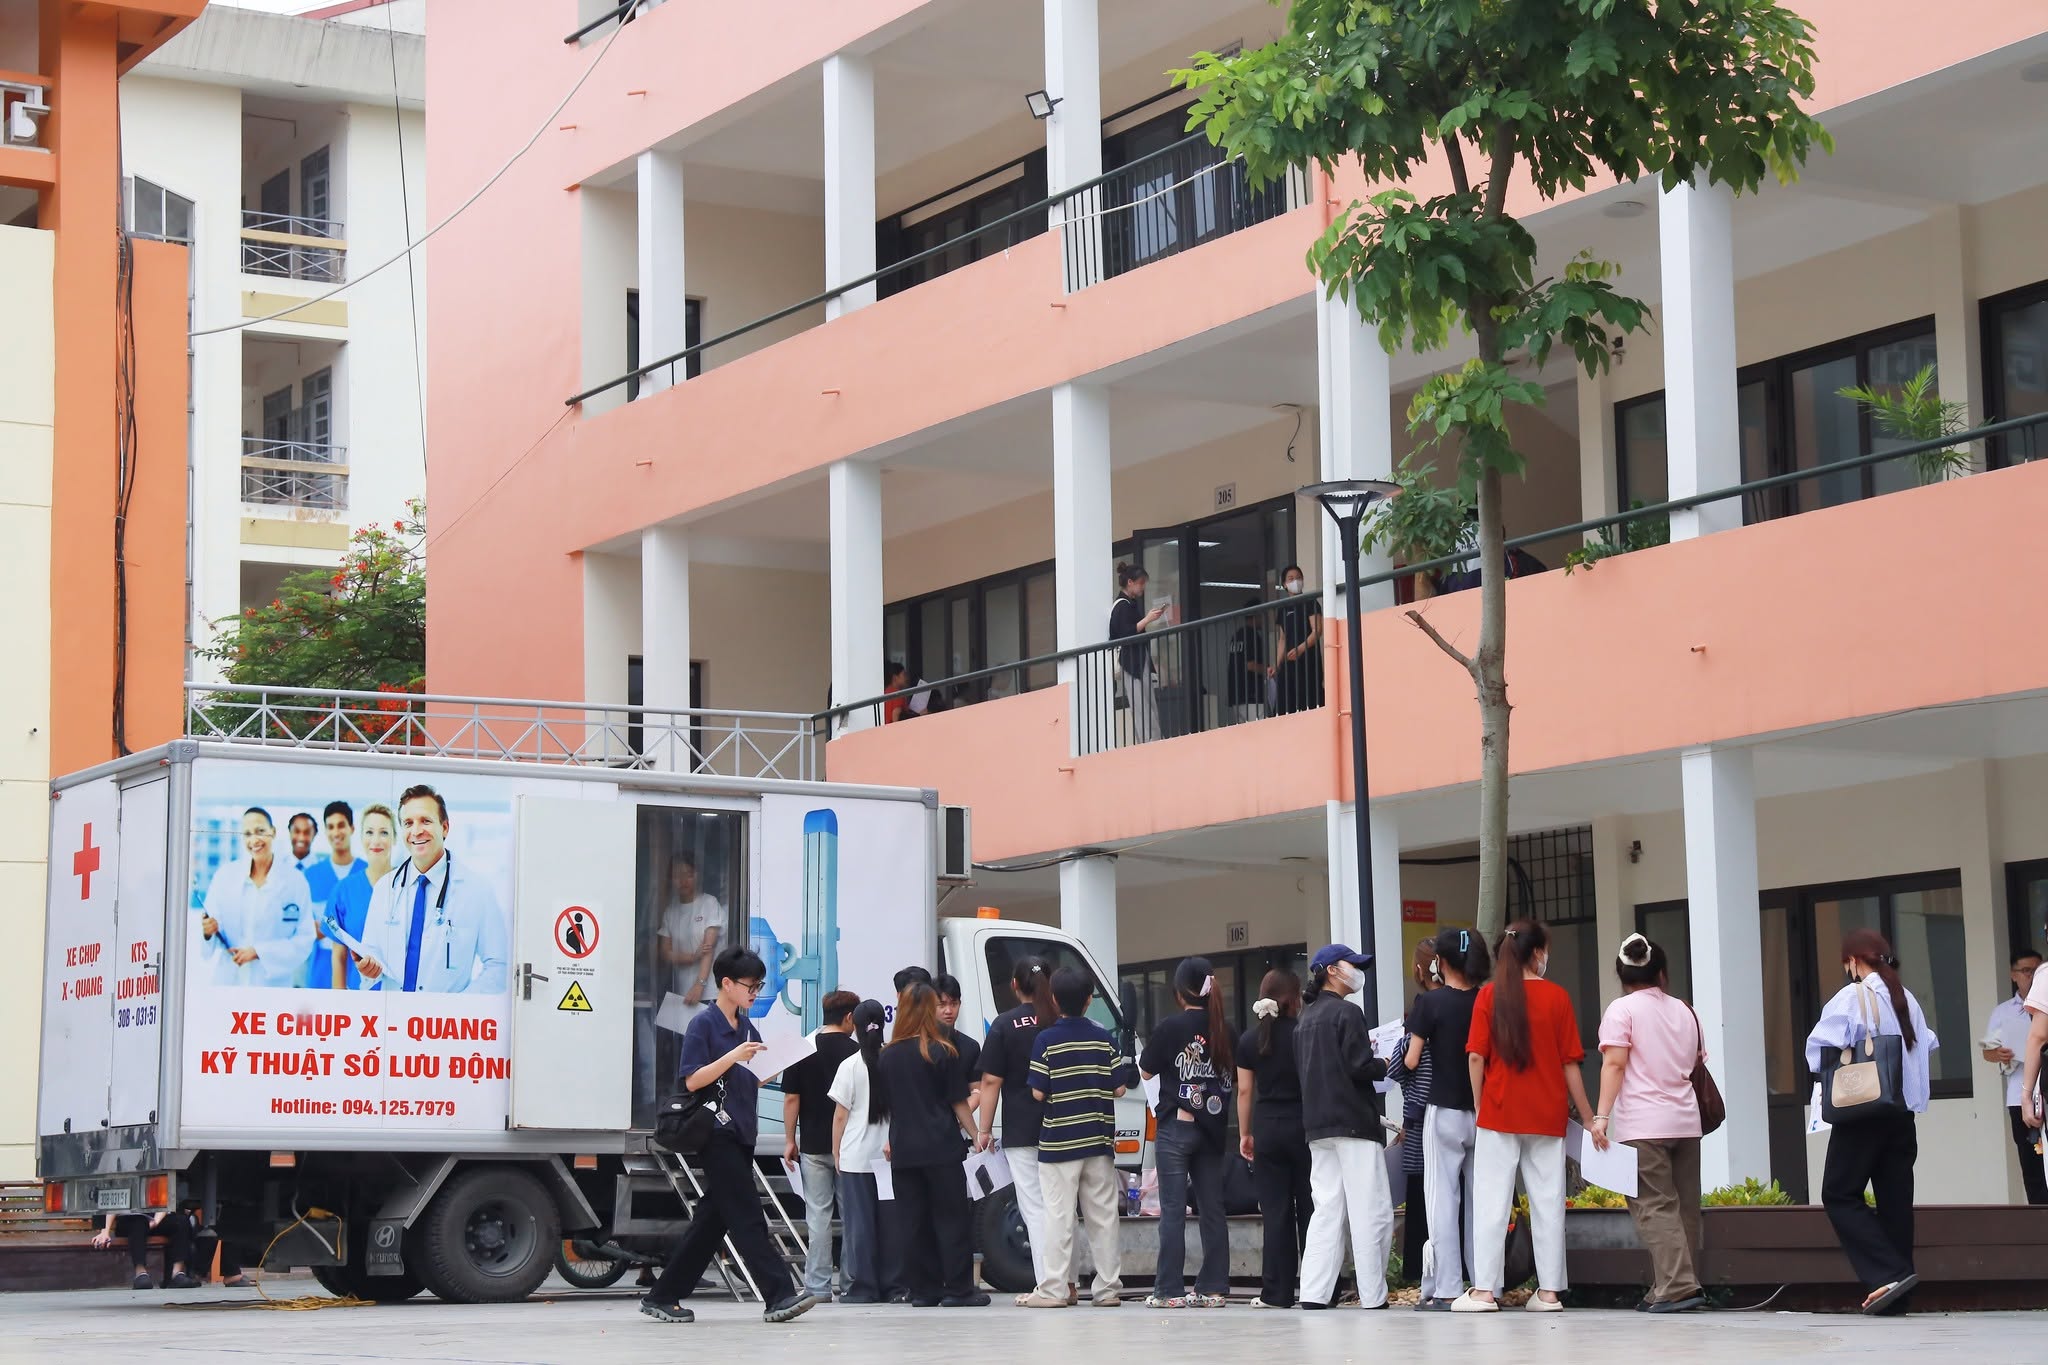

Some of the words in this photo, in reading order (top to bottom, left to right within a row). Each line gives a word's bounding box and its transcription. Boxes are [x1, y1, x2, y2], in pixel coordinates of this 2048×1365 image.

[1218, 489, 1232, 505] 205
[1231, 927, 1244, 942] 105
[66, 947, 77, 967] XE
[78, 942, 101, 967] CHỤP
[131, 941, 148, 963] KTS
[62, 981, 68, 1000] X
[75, 976, 103, 1000] QUANG
[117, 977, 134, 1000] LƯU
[230, 1012, 267, 1035] XE
[276, 1013, 352, 1042] CHỤP
[360, 1015, 379, 1038] X
[407, 1016, 497, 1042] QUANG
[201, 1046, 238, 1074] KỸ
[247, 1048, 335, 1081] THUẬT
[343, 1046, 382, 1077] SỐ
[389, 1053, 440, 1078] LƯU
[449, 1052, 511, 1084] ĐỘN
[271, 1098, 337, 1115] Hotline:
[342, 1099, 456, 1117] 094.125.7979
